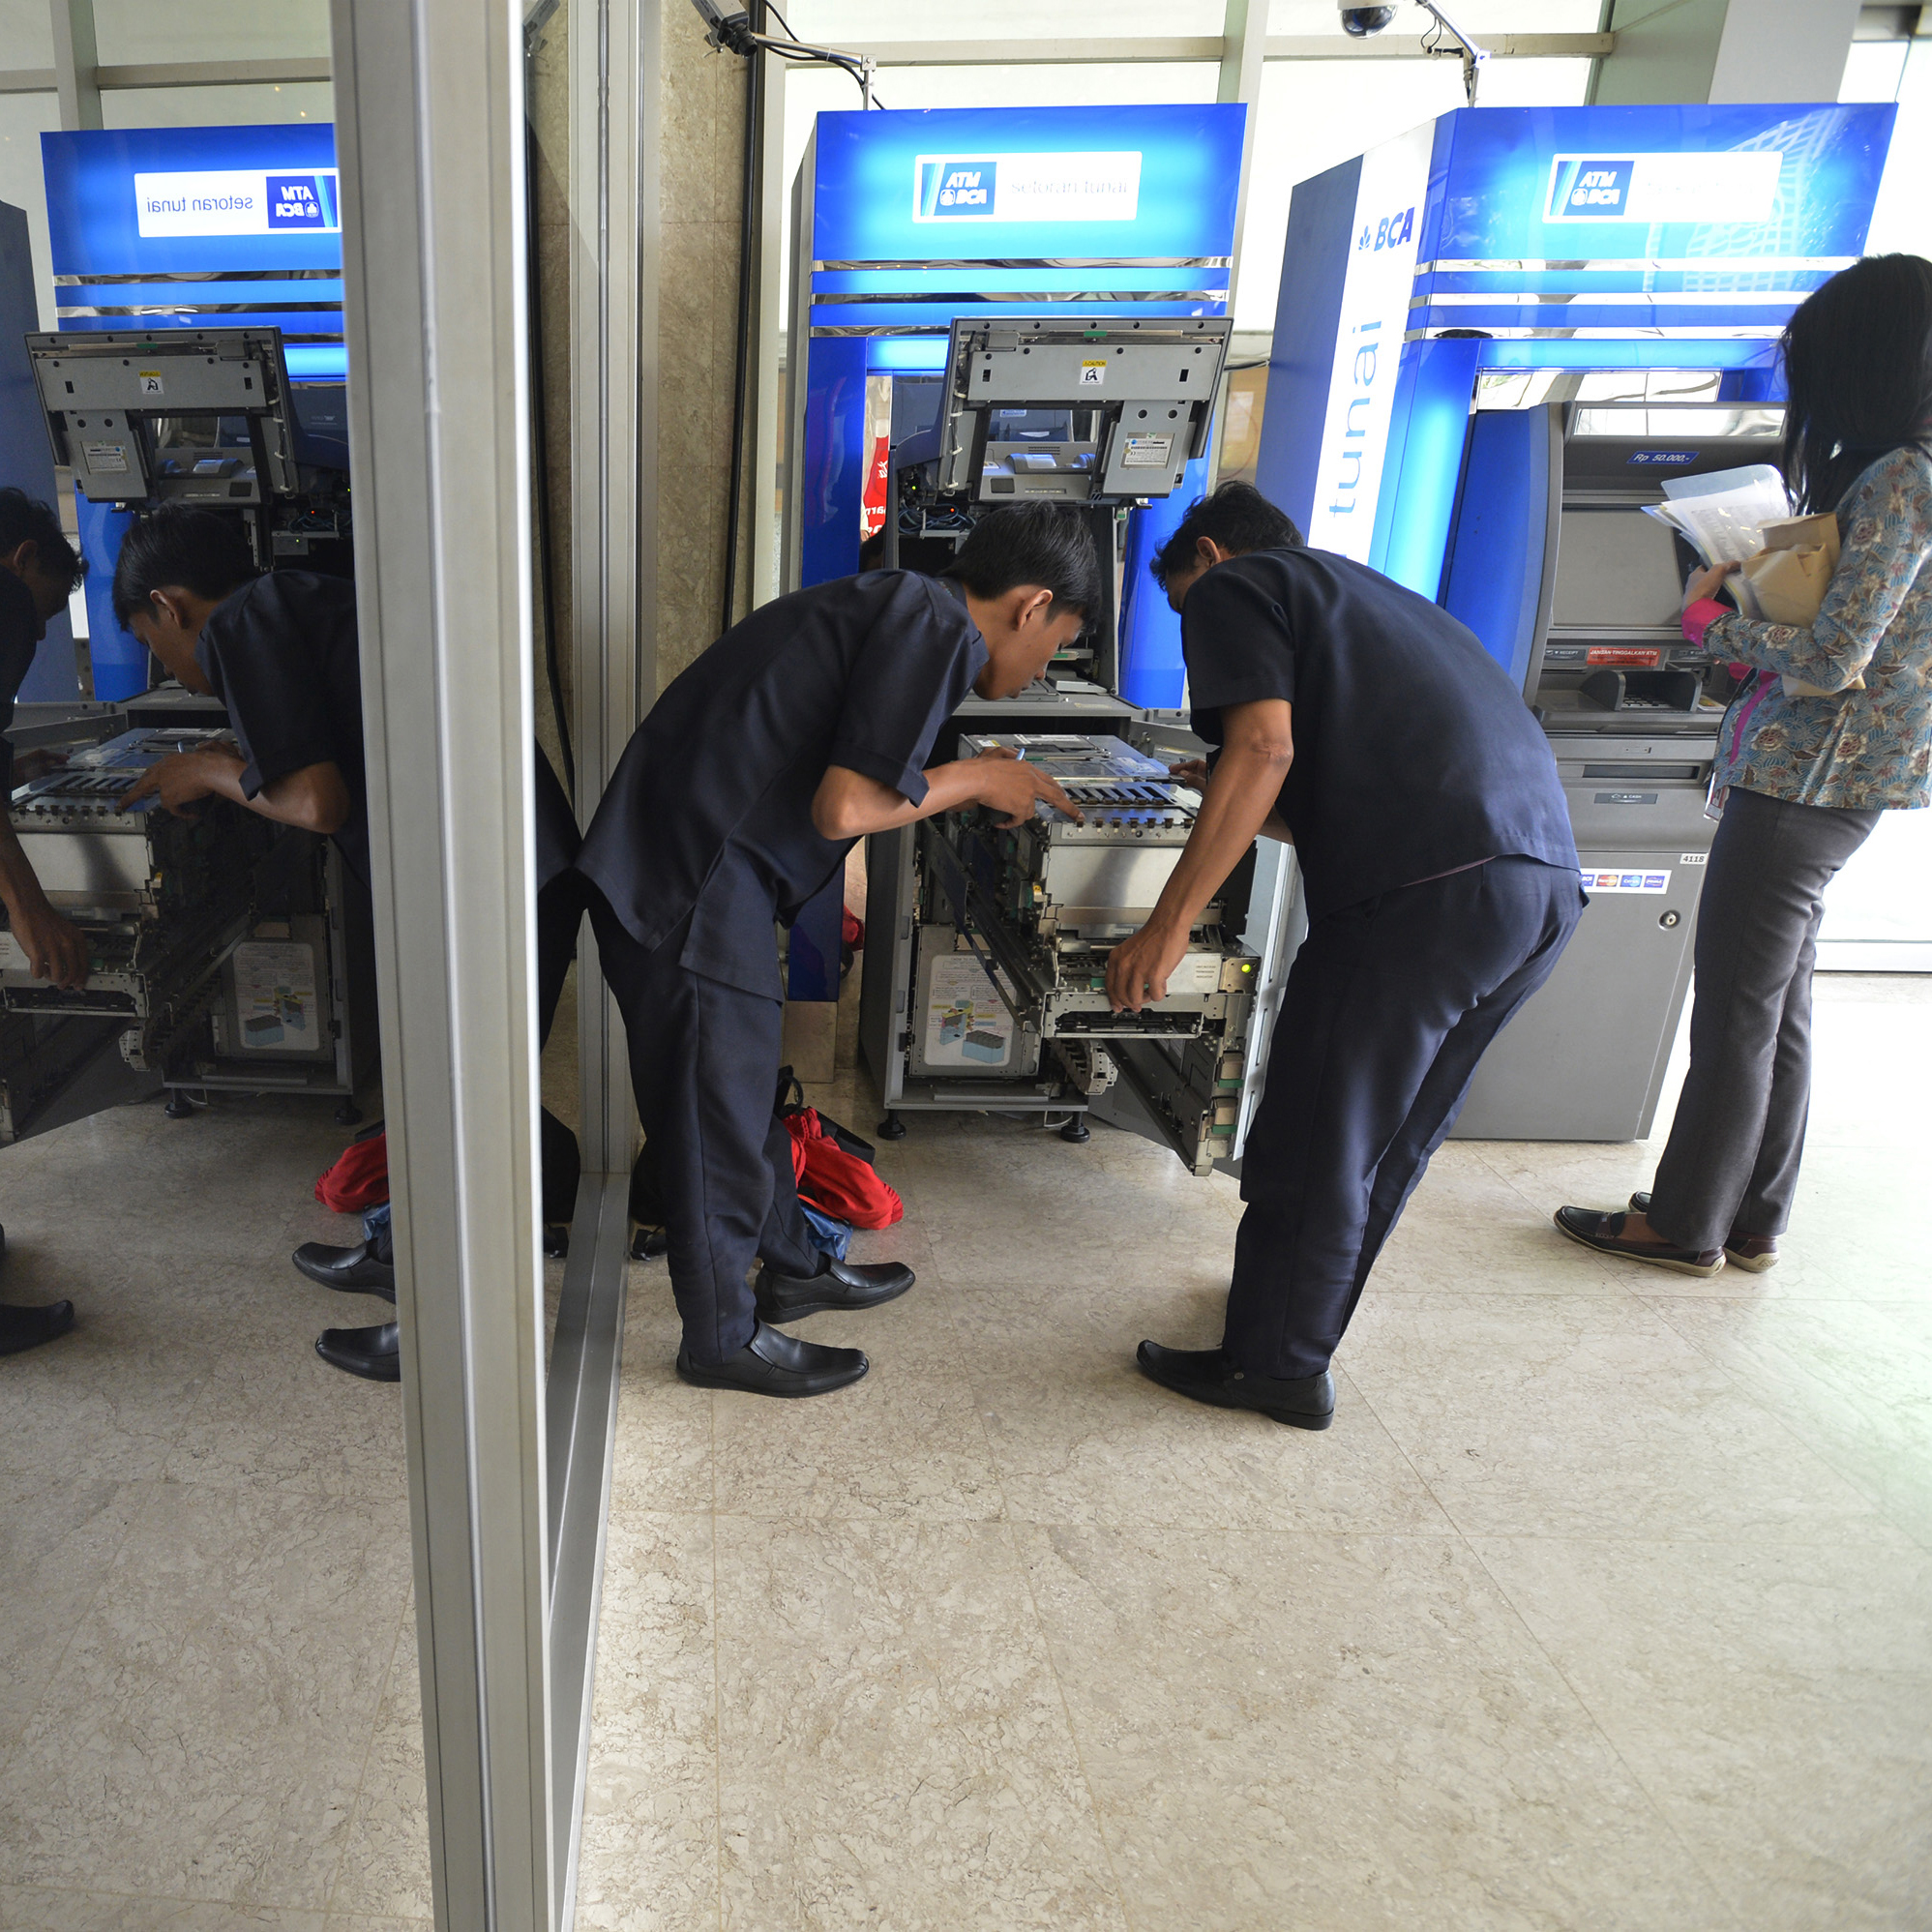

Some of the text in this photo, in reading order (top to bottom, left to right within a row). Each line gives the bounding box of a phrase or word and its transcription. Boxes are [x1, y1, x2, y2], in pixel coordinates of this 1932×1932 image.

[945, 171, 981, 188] ATM
[1011, 179, 1128, 193] setoran tunai
[1579, 171, 1617, 187] ATM
[955, 189, 987, 204] BCA
[1374, 206, 1415, 252] BCA
[1329, 320, 1382, 519] tunai
[1633, 454, 1650, 462] Rp
